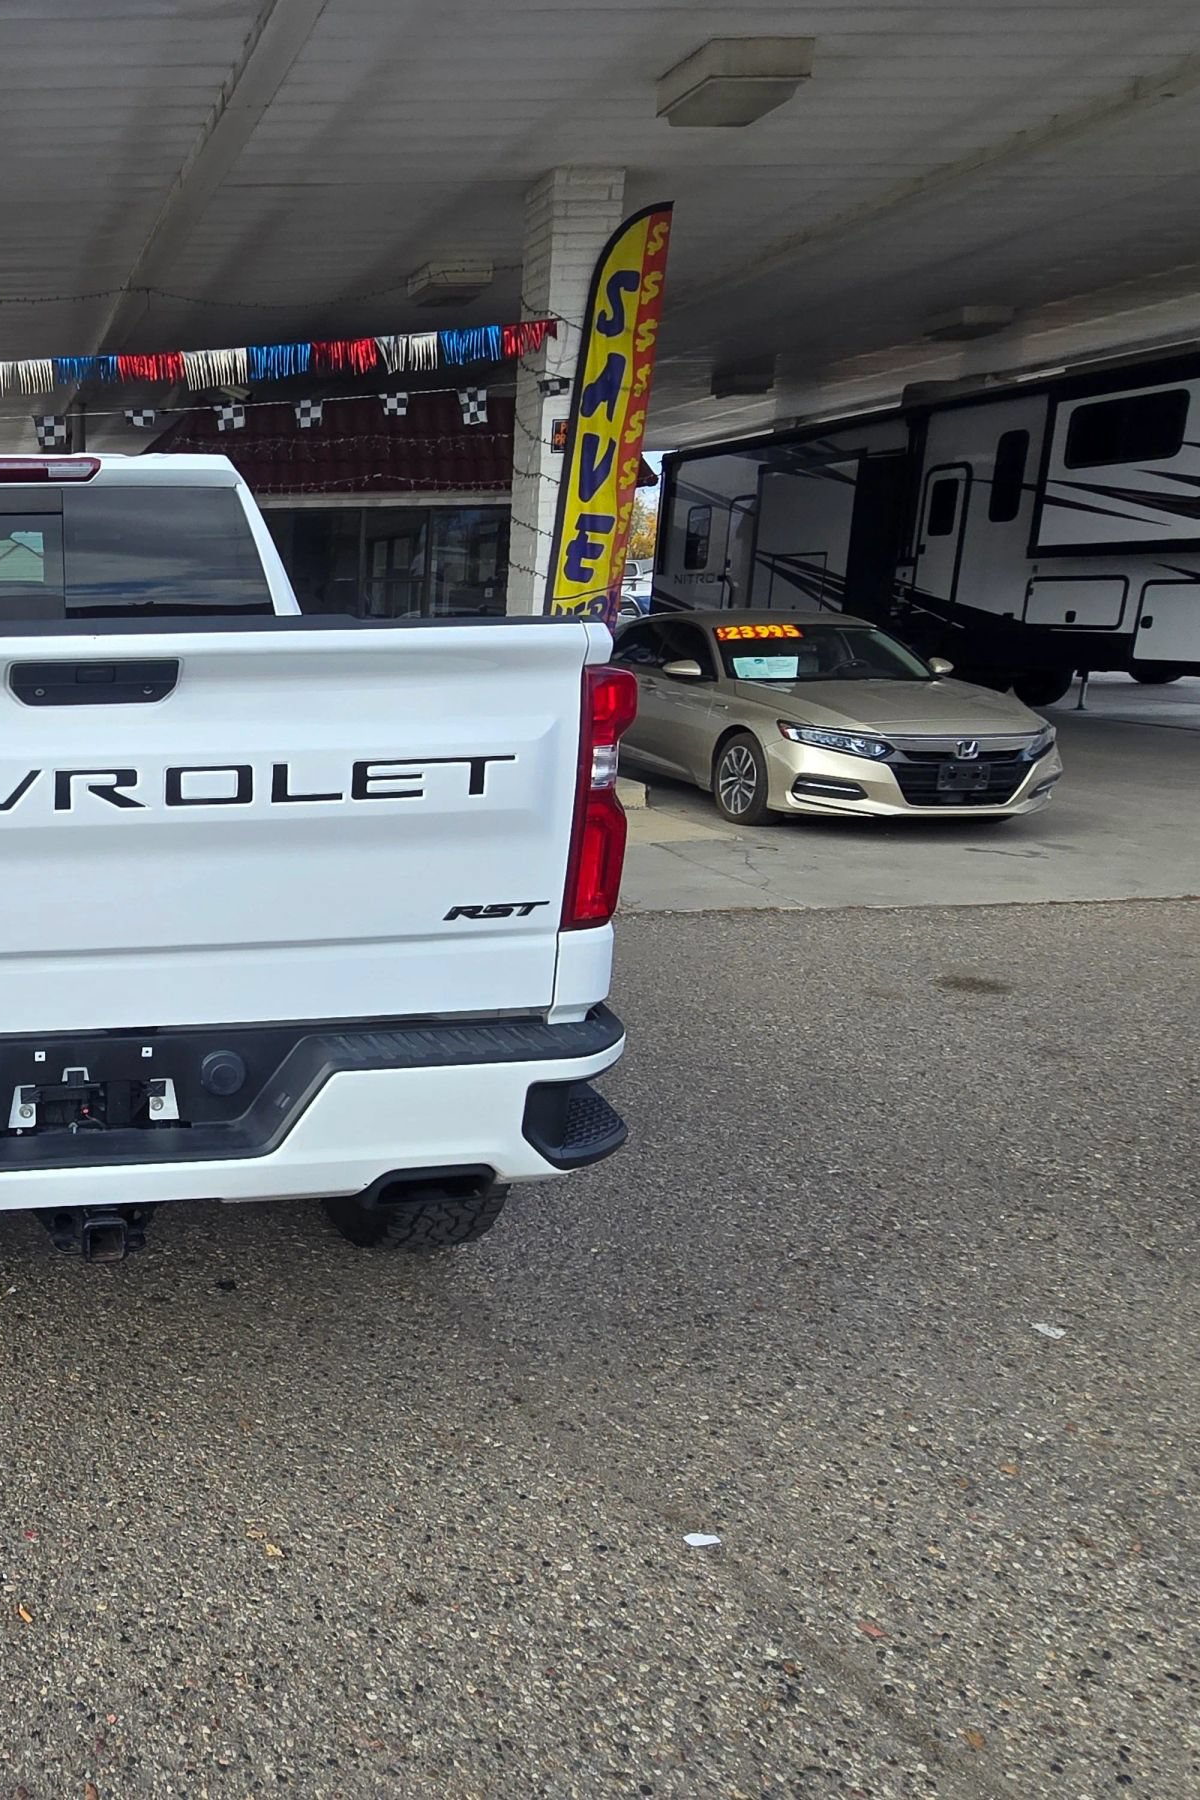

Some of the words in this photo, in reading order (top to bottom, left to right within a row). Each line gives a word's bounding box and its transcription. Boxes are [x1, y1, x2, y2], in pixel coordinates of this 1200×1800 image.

[563, 268, 641, 584] SAVE
[673, 573, 715, 585] NITRO
[716, 624, 801, 641] $23995
[443, 900, 550, 921] RST
